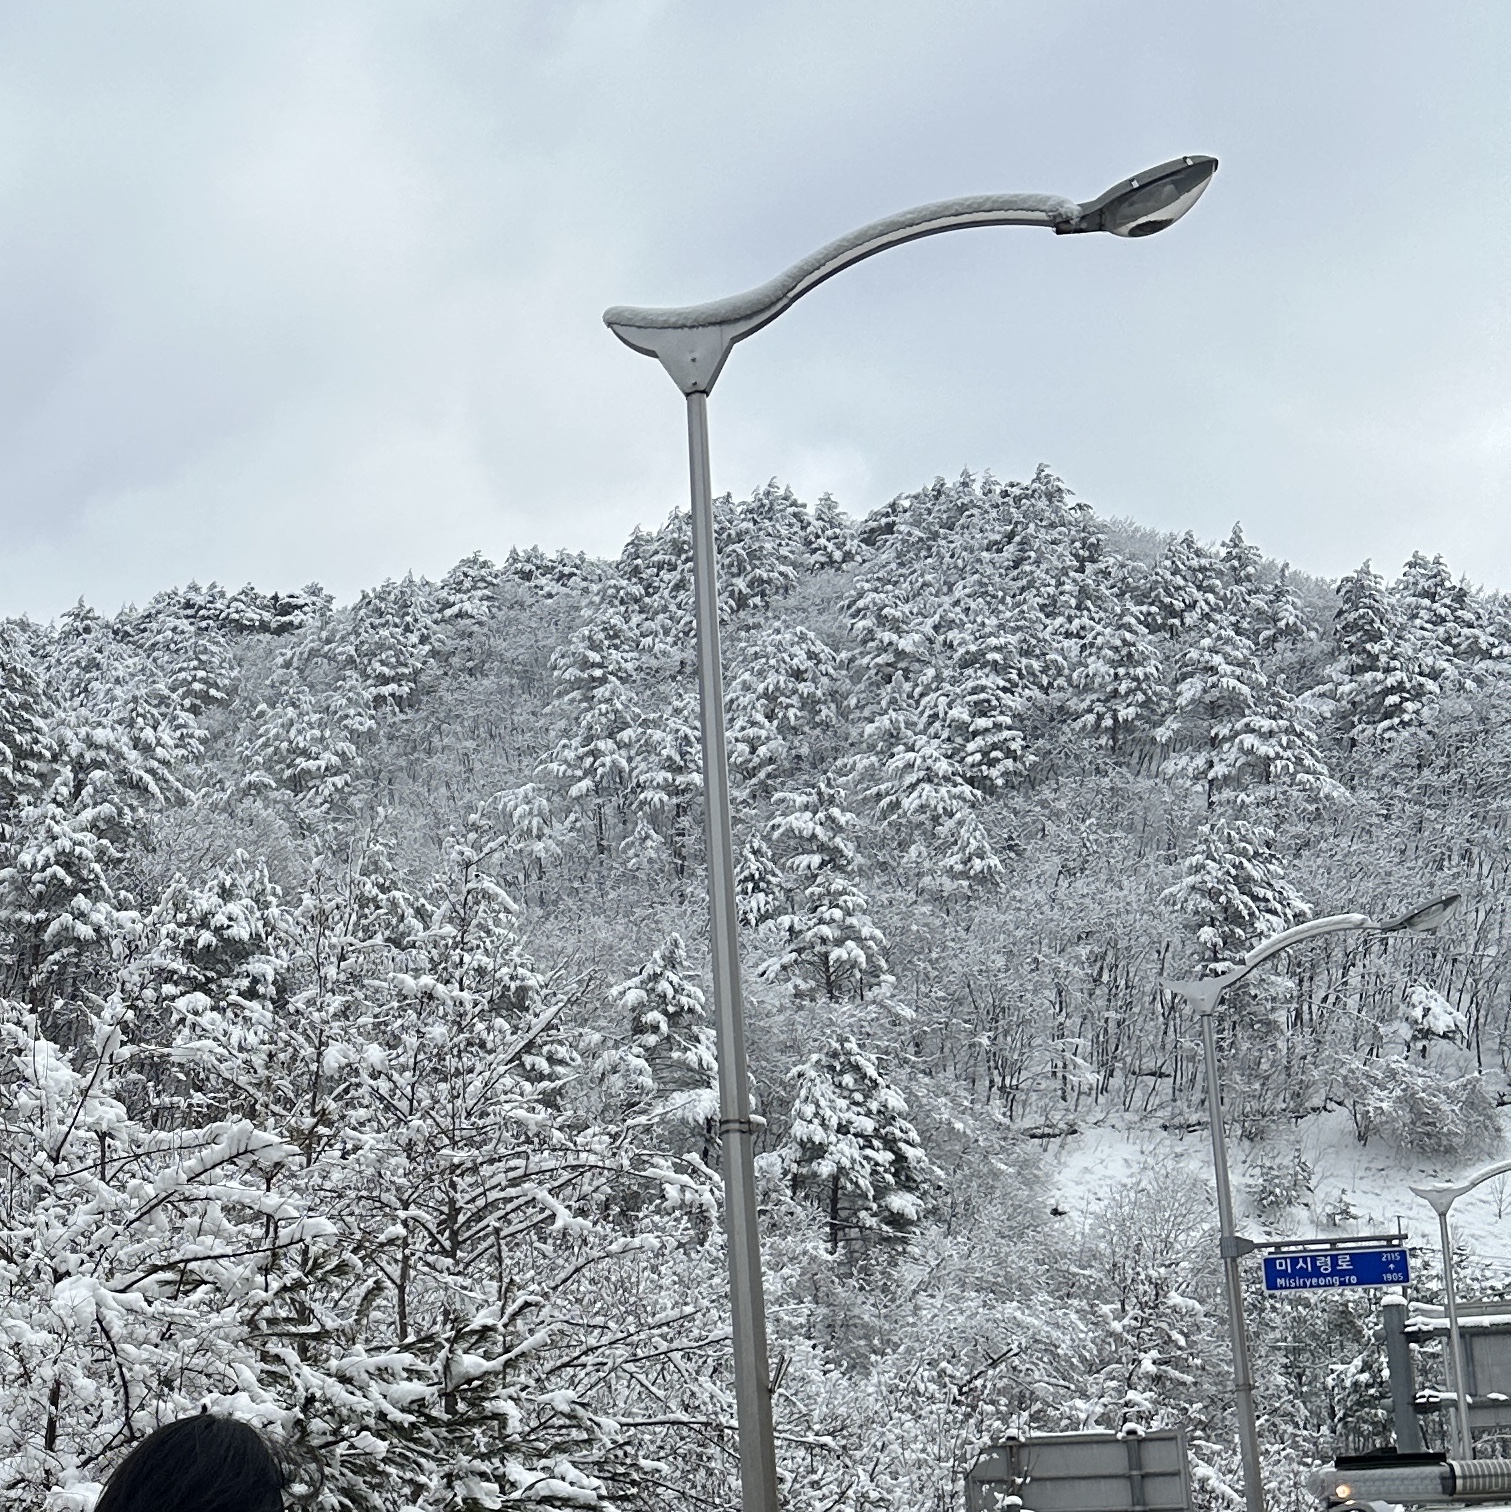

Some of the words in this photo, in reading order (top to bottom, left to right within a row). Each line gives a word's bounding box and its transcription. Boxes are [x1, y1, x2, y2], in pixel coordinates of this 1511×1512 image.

[1275, 1254, 1354, 1274] 미시령로
[1276, 1275, 1358, 1288] Misiryeong-ro
[1382, 1272, 1404, 1281] 1905
